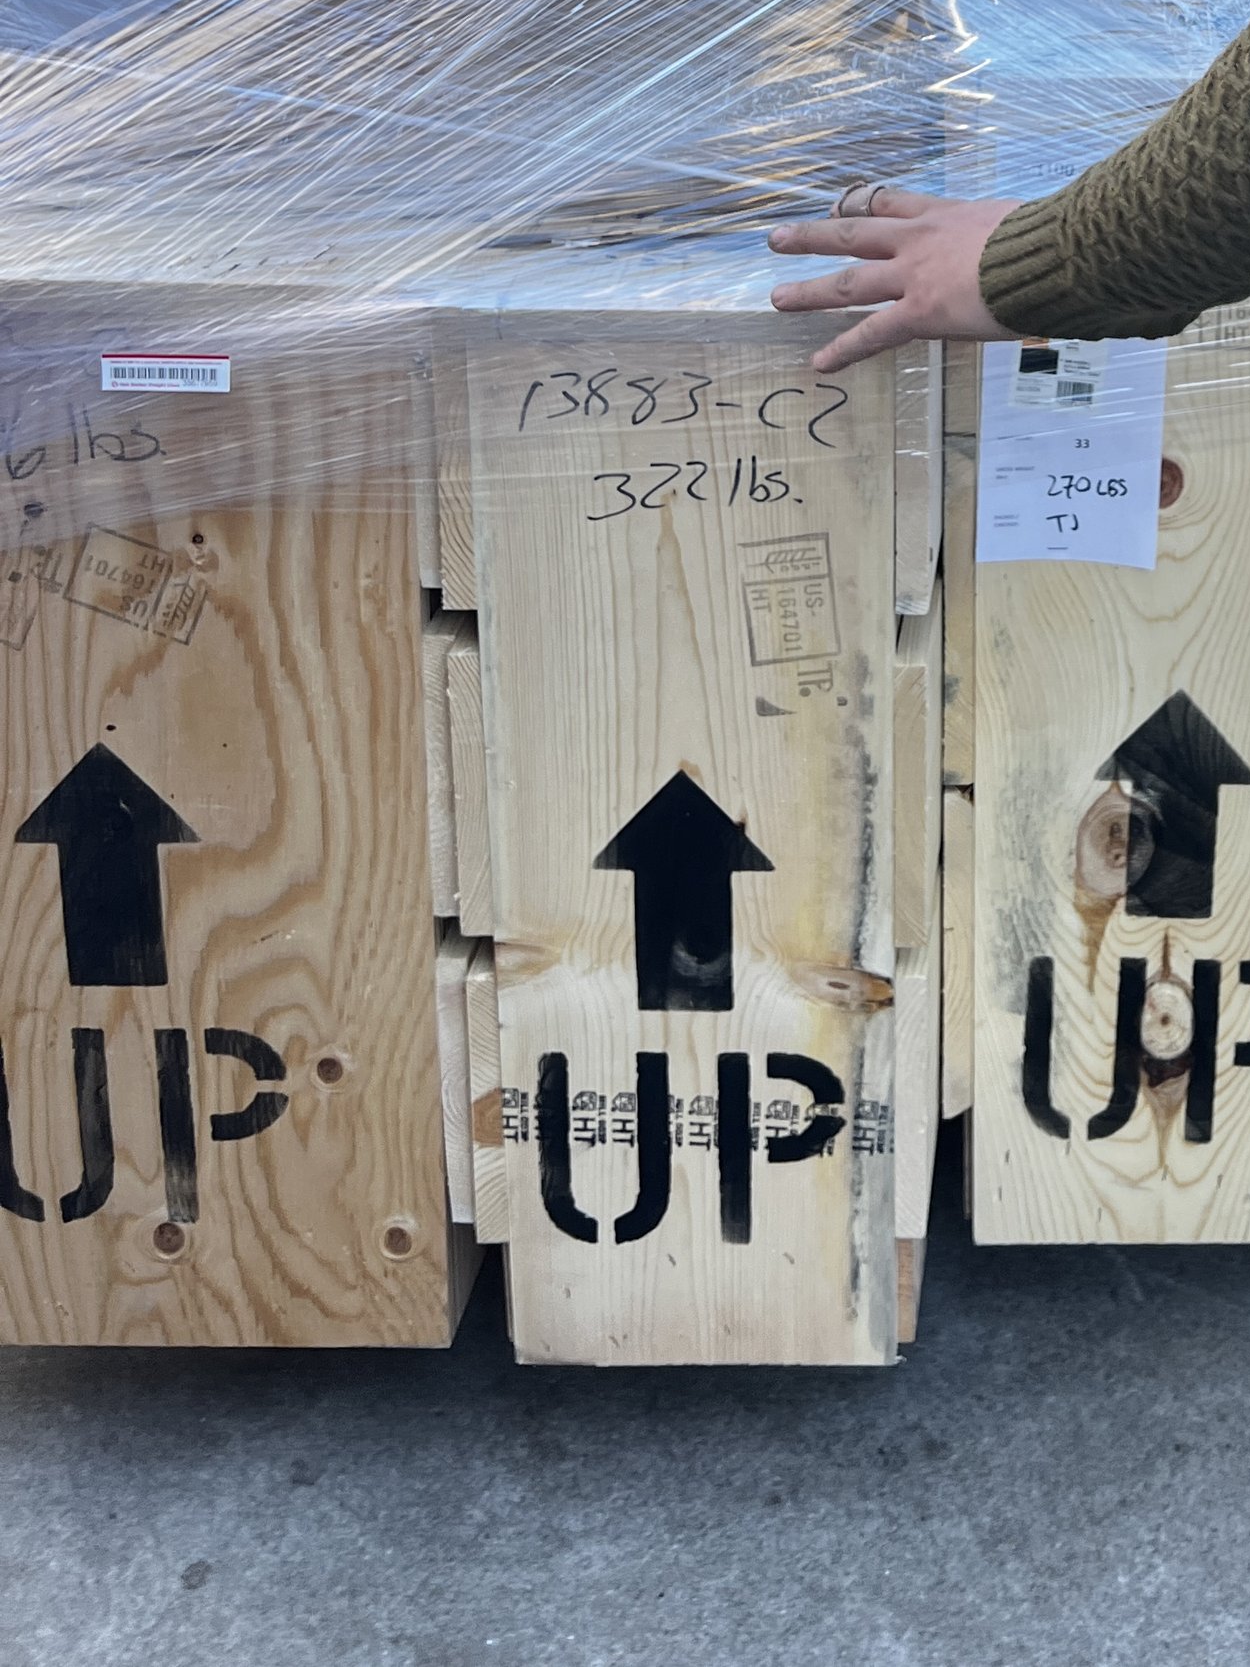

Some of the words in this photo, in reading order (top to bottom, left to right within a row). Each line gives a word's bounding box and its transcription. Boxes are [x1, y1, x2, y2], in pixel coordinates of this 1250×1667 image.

[1074, 438, 1091, 449] 33
[1047, 474, 1092, 500] 270
[1046, 513, 1079, 533] TJ
[751, 588, 772, 613] HT
[776, 587, 803, 653] 164701
[0, 1027, 290, 1224] UP
[501, 1114, 519, 1144] HT
[573, 1117, 597, 1148] HT
[611, 1118, 636, 1148] HT
[688, 1121, 712, 1151] HT
[537, 1051, 847, 1245] UP
[852, 1125, 877, 1157] HT
